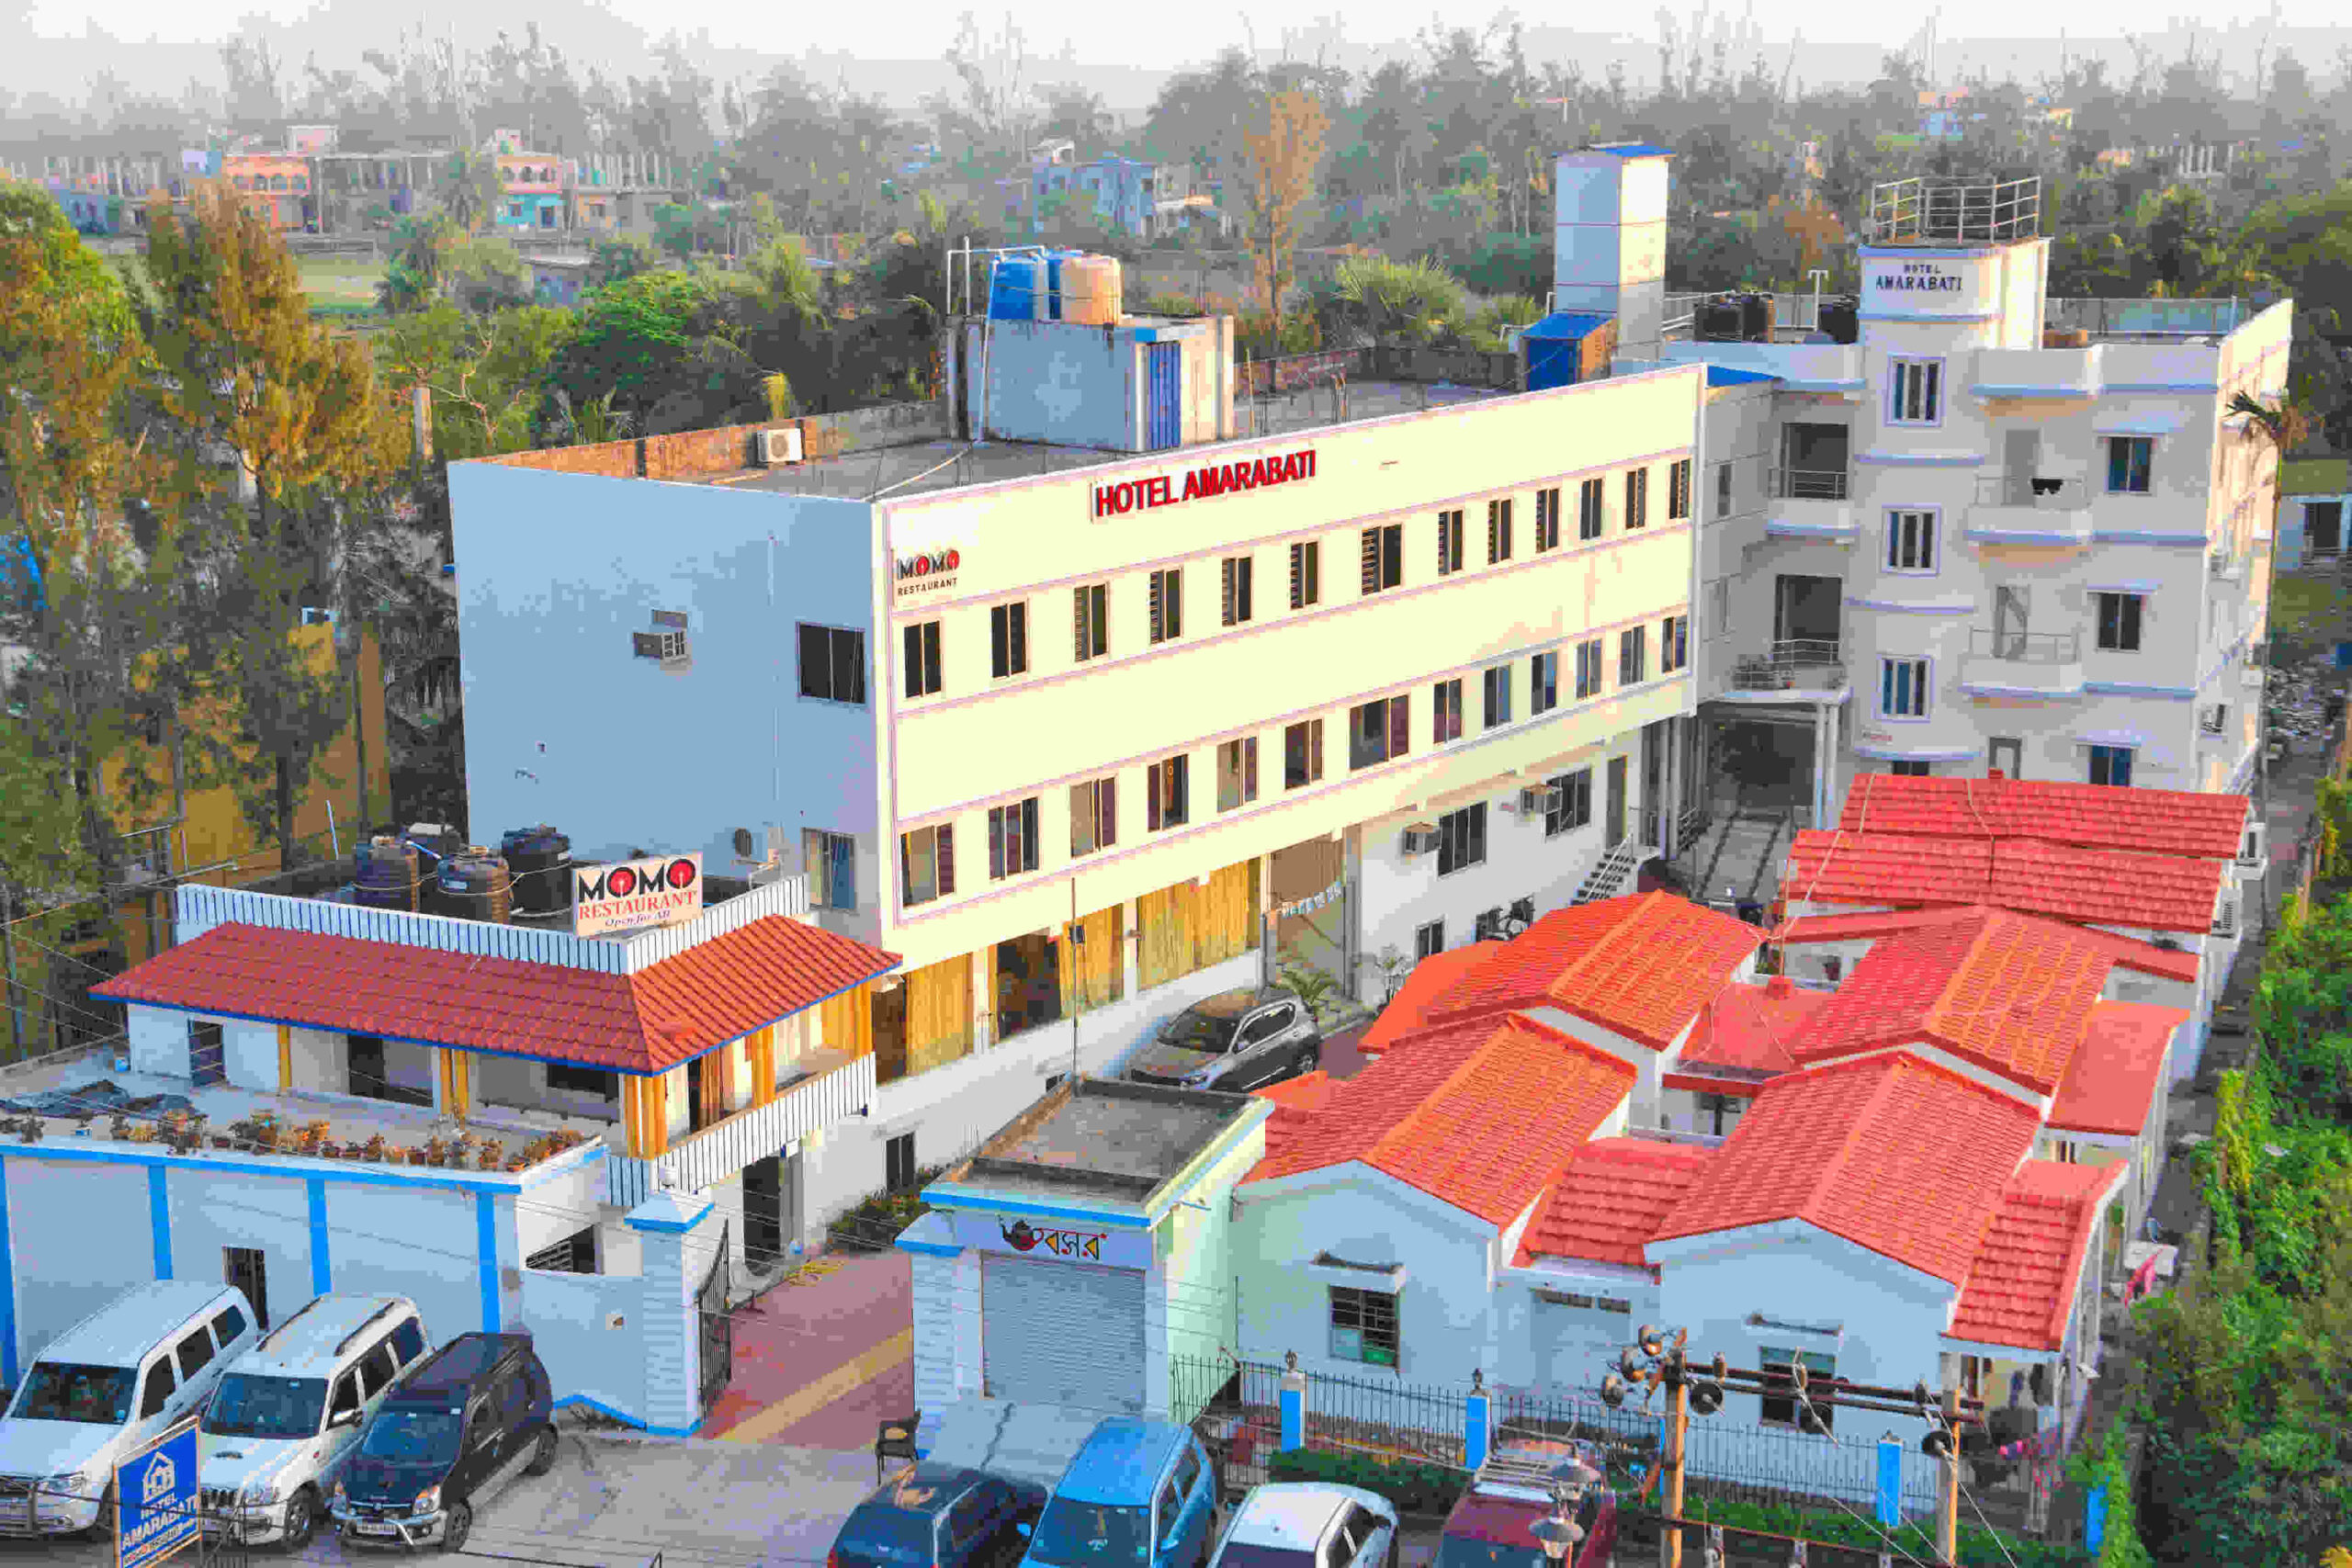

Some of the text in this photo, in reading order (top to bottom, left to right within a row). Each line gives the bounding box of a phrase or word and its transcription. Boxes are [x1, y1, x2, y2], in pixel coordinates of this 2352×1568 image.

[1876, 276, 1962, 291] AMARABATI
[1904, 265, 1941, 274] HOTEL
[1096, 449, 1317, 517] HOTEL AMARABATI
[898, 549, 960, 580] MOMO
[898, 577, 957, 595] RESTAURANT
[578, 858, 696, 903] MOMO
[578, 890, 697, 919] RESTAURANT
[605, 917, 633, 928] Open
[121, 1494, 198, 1551] AMARABATI
